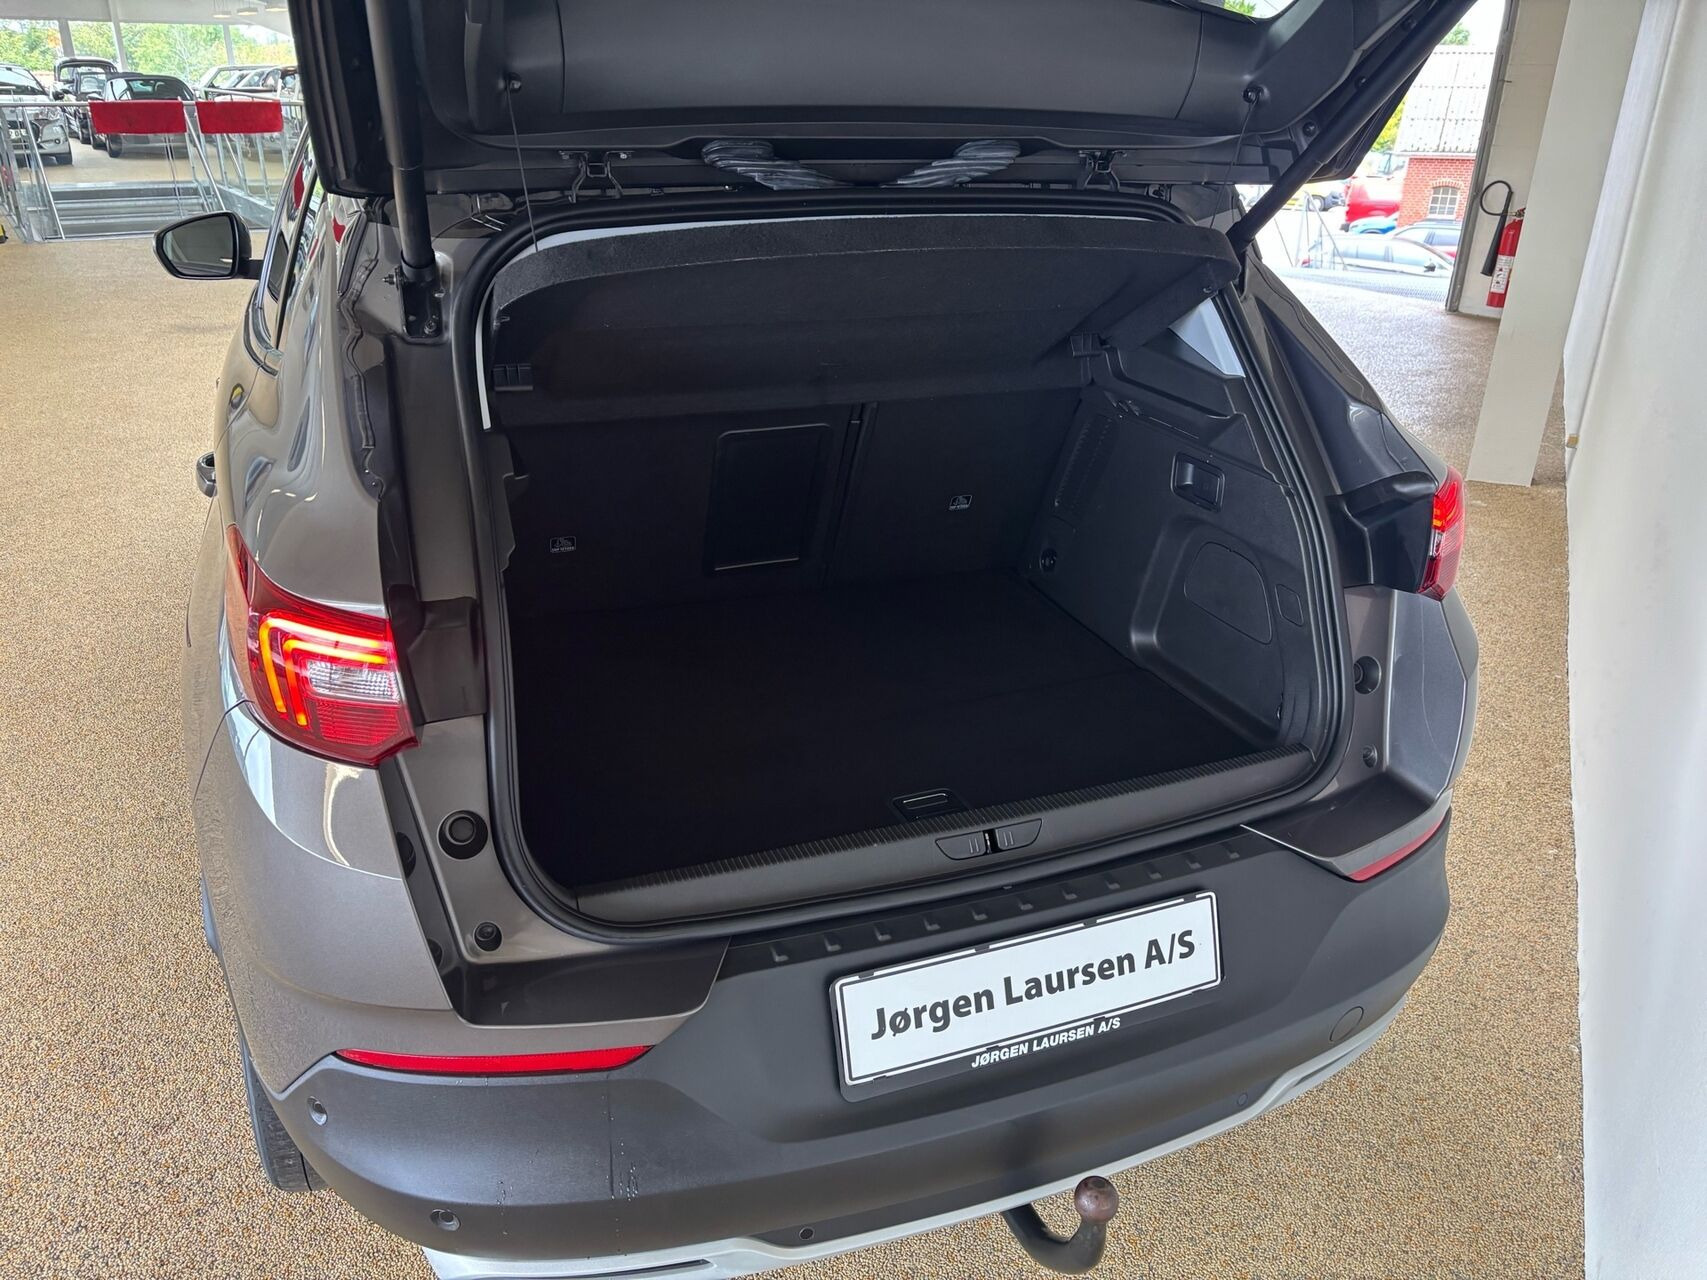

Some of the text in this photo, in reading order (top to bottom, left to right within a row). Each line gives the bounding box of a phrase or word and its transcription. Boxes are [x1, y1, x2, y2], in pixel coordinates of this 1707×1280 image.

[871, 929, 1195, 1041] Jørgen Laursen A/S
[971, 1017, 1121, 1068] JØRGEN LAURSEN A/S
